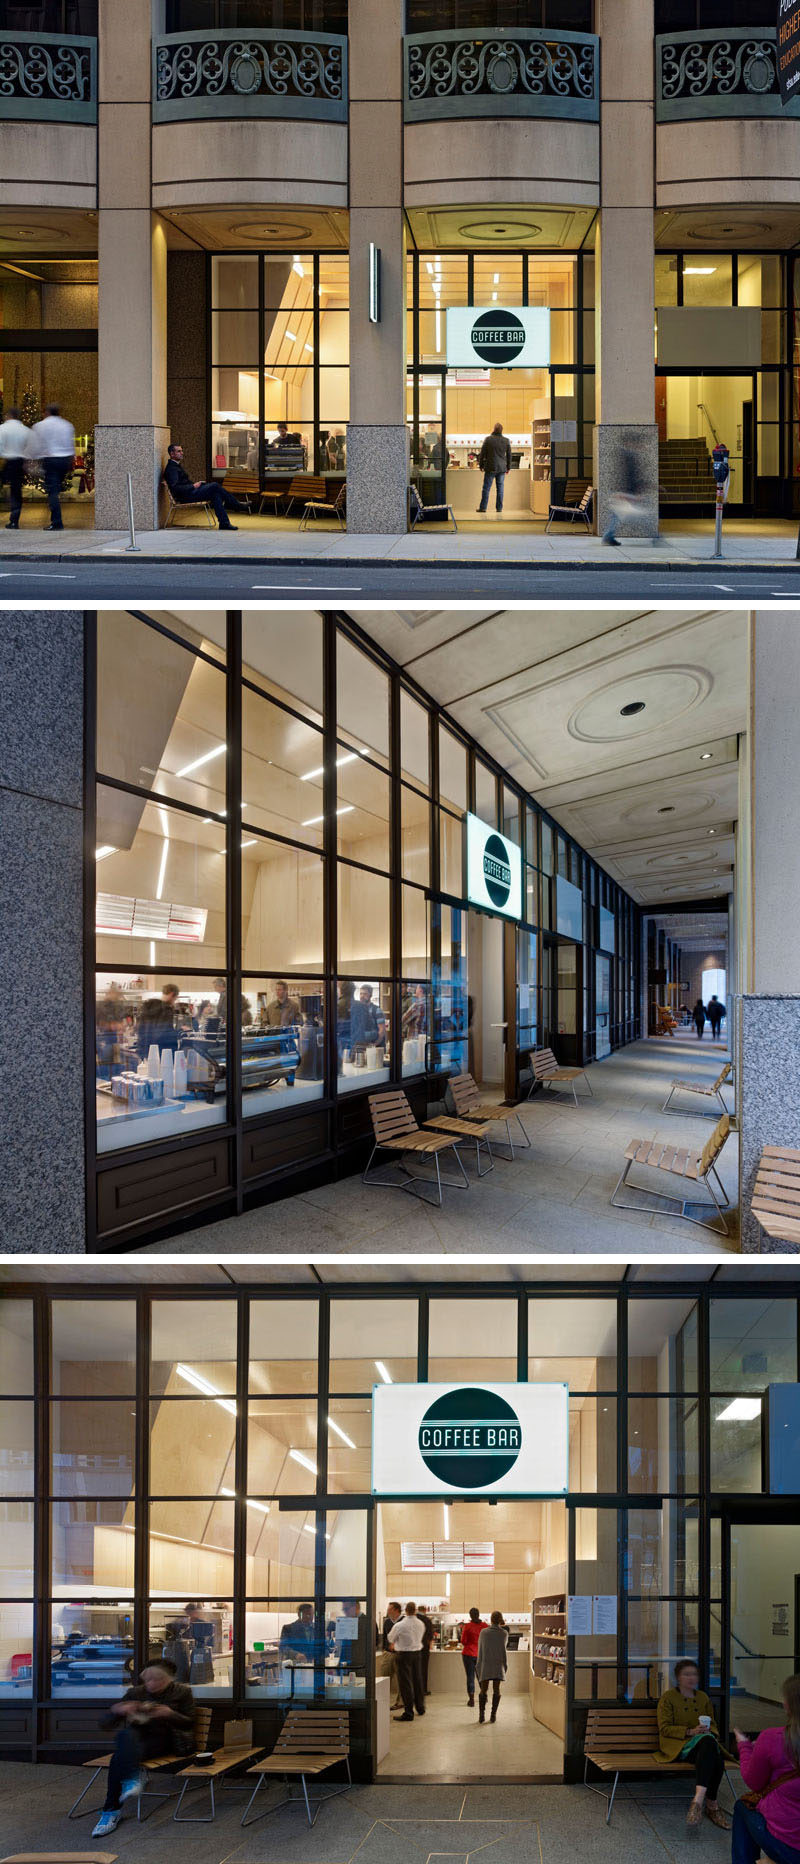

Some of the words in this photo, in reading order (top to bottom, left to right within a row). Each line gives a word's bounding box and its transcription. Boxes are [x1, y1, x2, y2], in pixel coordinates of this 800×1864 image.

[472, 331, 504, 342] COFFEE
[506, 331, 525, 342] BAR
[484, 857, 502, 880] COFFEE
[501, 867, 511, 883] BAR
[422, 1428, 481, 1447] COFFEE
[487, 1428, 519, 1447] BAR
